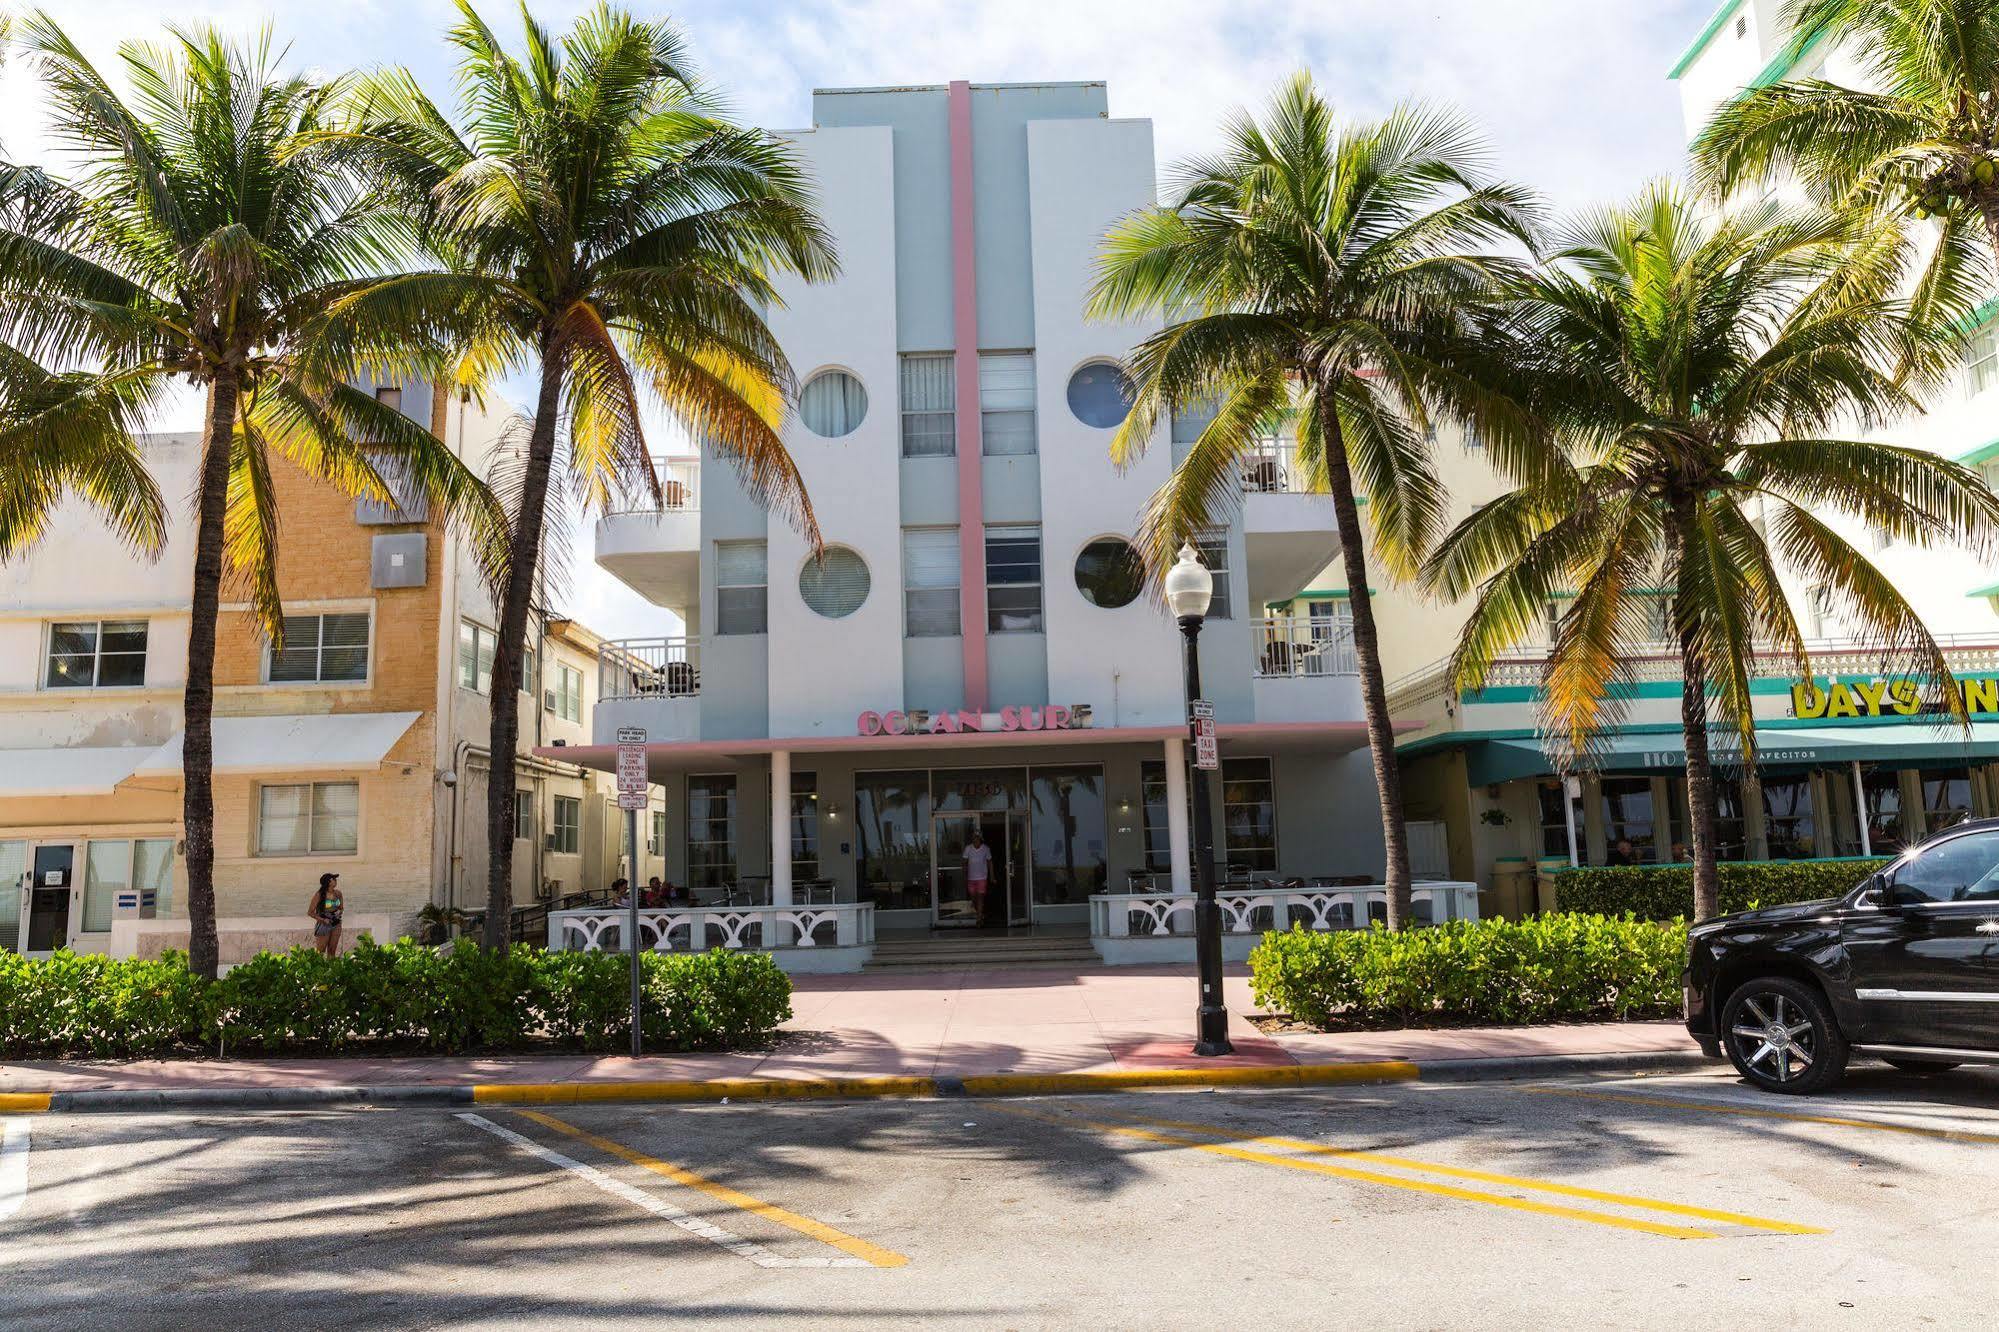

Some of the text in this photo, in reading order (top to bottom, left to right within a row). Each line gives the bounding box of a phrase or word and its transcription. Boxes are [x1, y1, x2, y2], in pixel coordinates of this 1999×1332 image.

[1792, 681, 1922, 718] DAYS
[857, 704, 1092, 736] OCEAN SURF
[1201, 739, 1214, 749] TAXI
[1200, 750, 1215, 760] ZONE
[1751, 751, 1816, 761] AFECITOS
